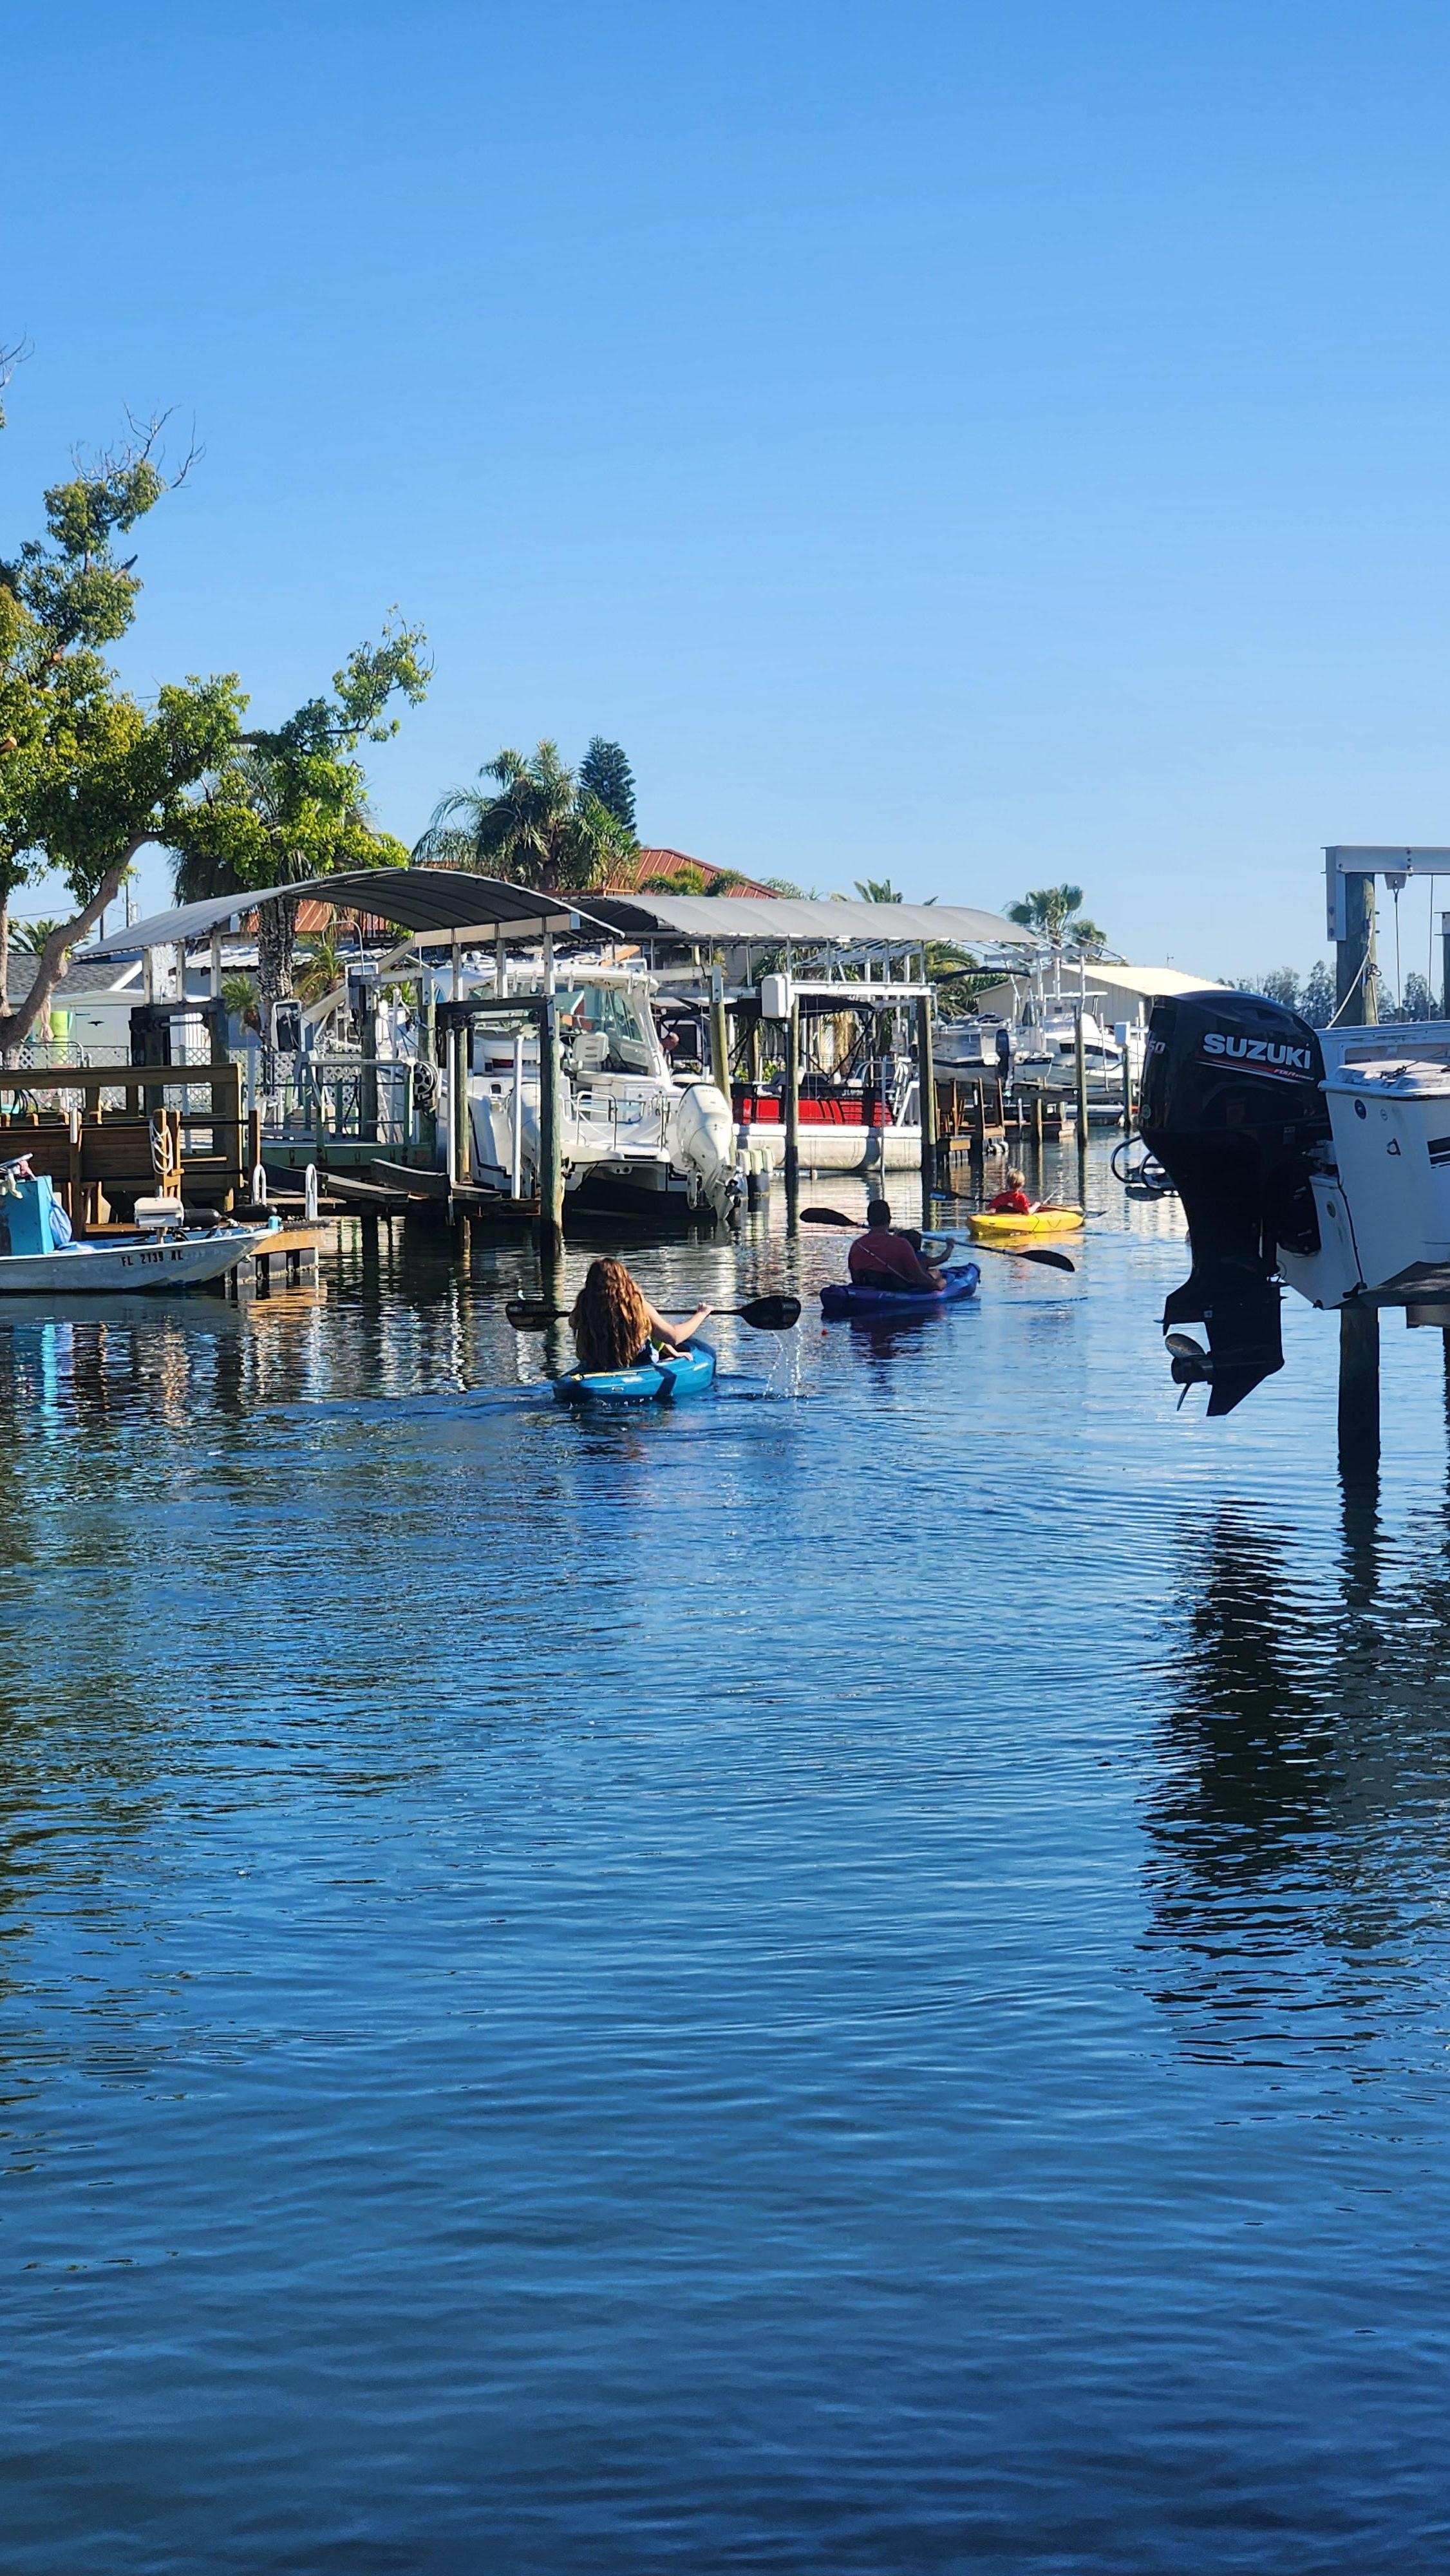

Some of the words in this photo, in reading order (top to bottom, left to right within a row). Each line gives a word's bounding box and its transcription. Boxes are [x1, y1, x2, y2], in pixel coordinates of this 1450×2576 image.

[1203, 1033, 1311, 1070] SUZUKI
[122, 1256, 133, 1266] FL
[171, 1250, 184, 1260] AL
